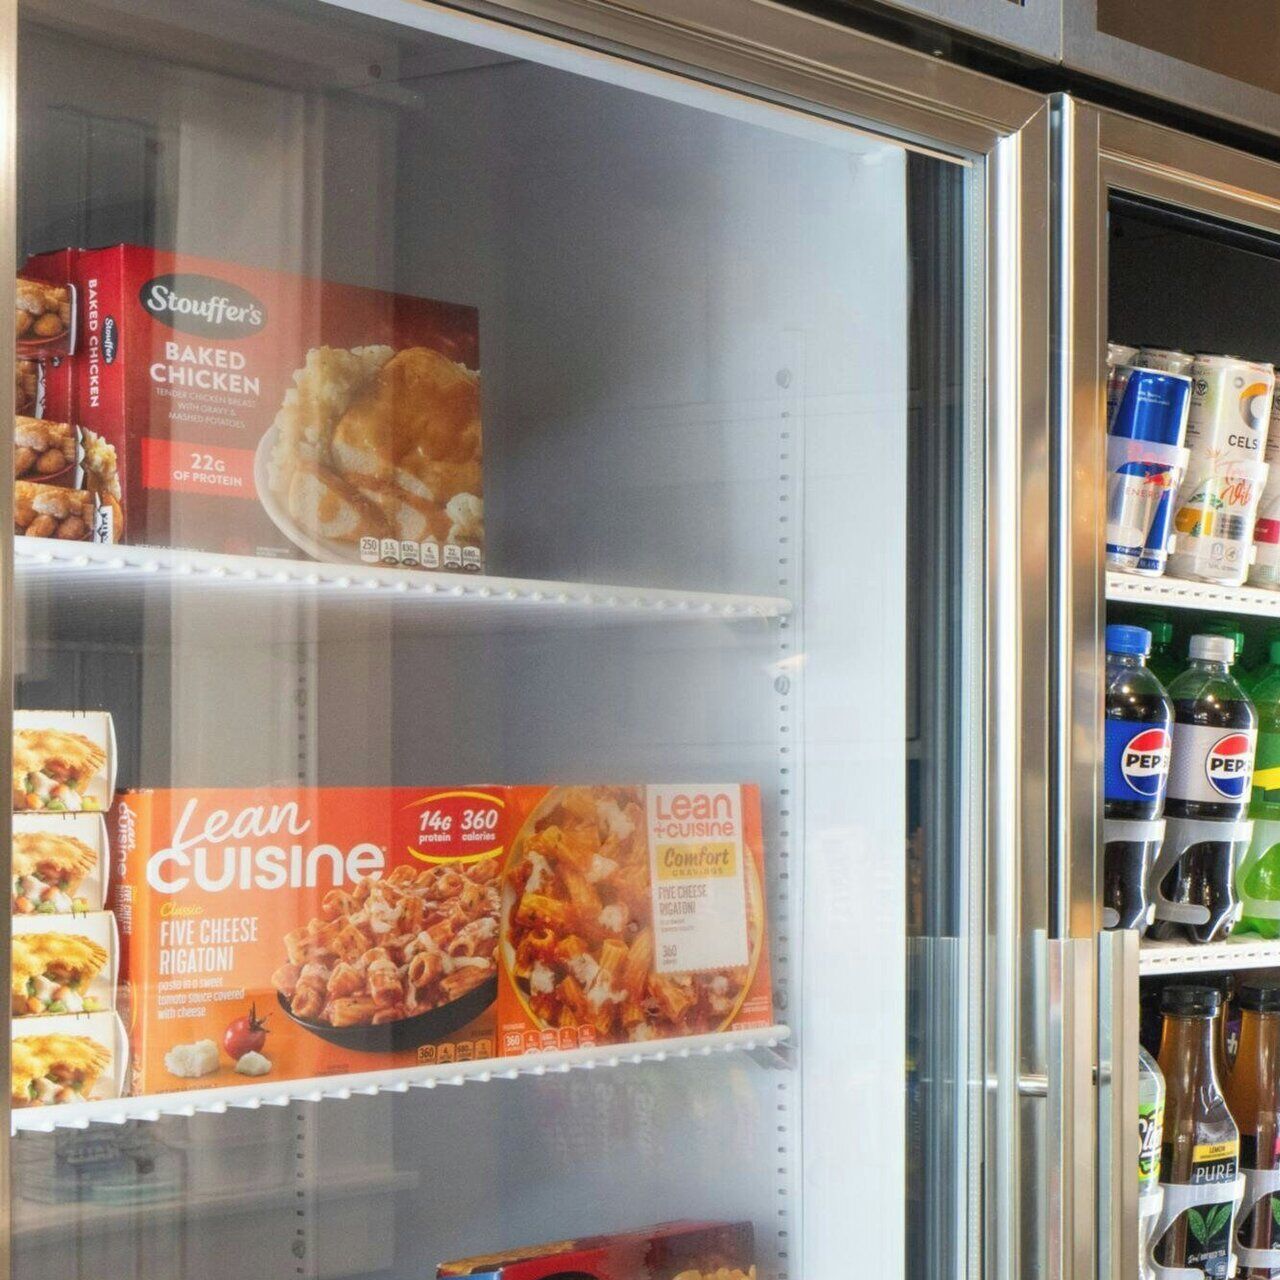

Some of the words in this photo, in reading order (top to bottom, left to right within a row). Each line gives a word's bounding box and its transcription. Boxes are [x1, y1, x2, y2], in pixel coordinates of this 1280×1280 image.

[88, 278, 98, 331] BAKED
[146, 285, 262, 326] Stouffer's
[165, 342, 246, 371] BAKED
[89, 334, 99, 409] CHICKEN
[149, 362, 260, 395] CHICKEN
[191, 453, 226, 472] 22G
[173, 470, 191, 481] OF
[192, 473, 242, 487] PROTEIN
[461, 809, 498, 830] 360
[655, 794, 732, 820] Lean
[172, 797, 311, 851] Lean
[419, 832, 451, 845] protein
[462, 831, 495, 842] calories
[663, 847, 730, 868] Comfort
[160, 920, 194, 946] FIVE
[201, 917, 258, 943] CHEESE
[160, 946, 234, 975] RIGATONI
[1196, 1161, 1234, 1183] PURE
